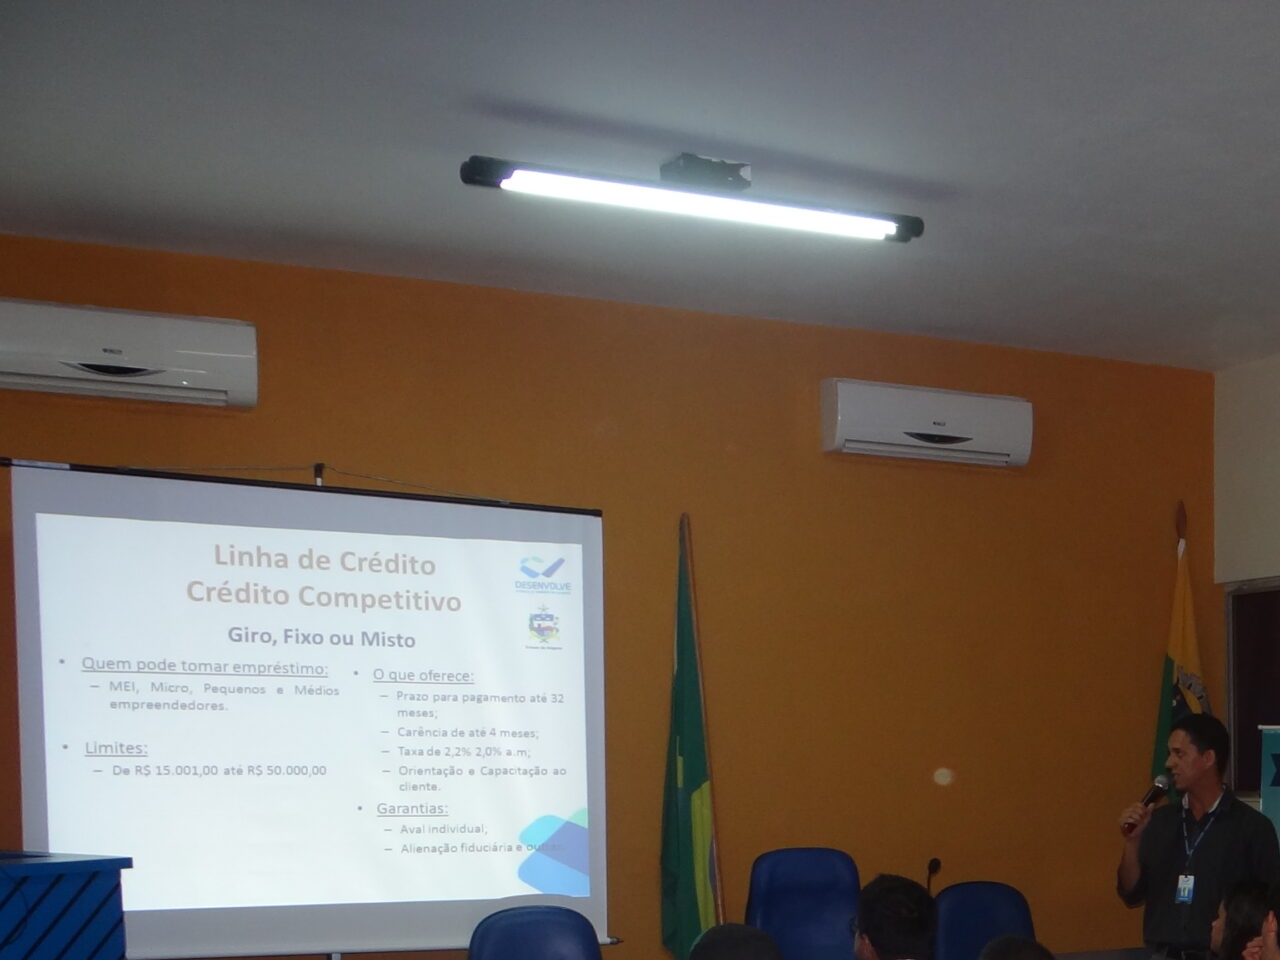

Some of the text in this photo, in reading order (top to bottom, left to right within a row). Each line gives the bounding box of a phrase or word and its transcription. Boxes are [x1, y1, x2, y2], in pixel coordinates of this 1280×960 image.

[214, 544, 436, 575] Linha de Crédito
[515, 580, 572, 591] DESENVOLVE
[186, 580, 462, 613] Crédito Competitivo
[228, 626, 416, 648] Giro, Fixo ou Misto
[81, 656, 329, 677] Quem pode tomar empréstimo:
[372, 668, 475, 683] O que oferece:
[109, 681, 340, 697] MEI, Micro, Pequenos e Médios
[396, 690, 565, 705] Prazo para pagamento até 32
[109, 700, 229, 713] empreendedores.
[397, 709, 439, 720] meses;
[397, 726, 539, 740] Carência de até 4 meses;
[85, 740, 148, 756] Limites:
[398, 746, 424, 757] Taxa
[426, 746, 441, 757] de
[444, 746, 472, 758] 2,2%
[475, 746, 502, 758] 2,0%
[112, 764, 327, 778] De R$ 15.001,00 até R$ 50.000,00
[398, 765, 568, 778] Orientação e Capacitação ao
[398, 781, 441, 792] cliente.
[376, 802, 449, 816] Garantias:
[399, 824, 425, 835] Aval
[400, 842, 458, 856] Alienação
[460, 842, 513, 854] fiduciária
[515, 844, 523, 853] e
